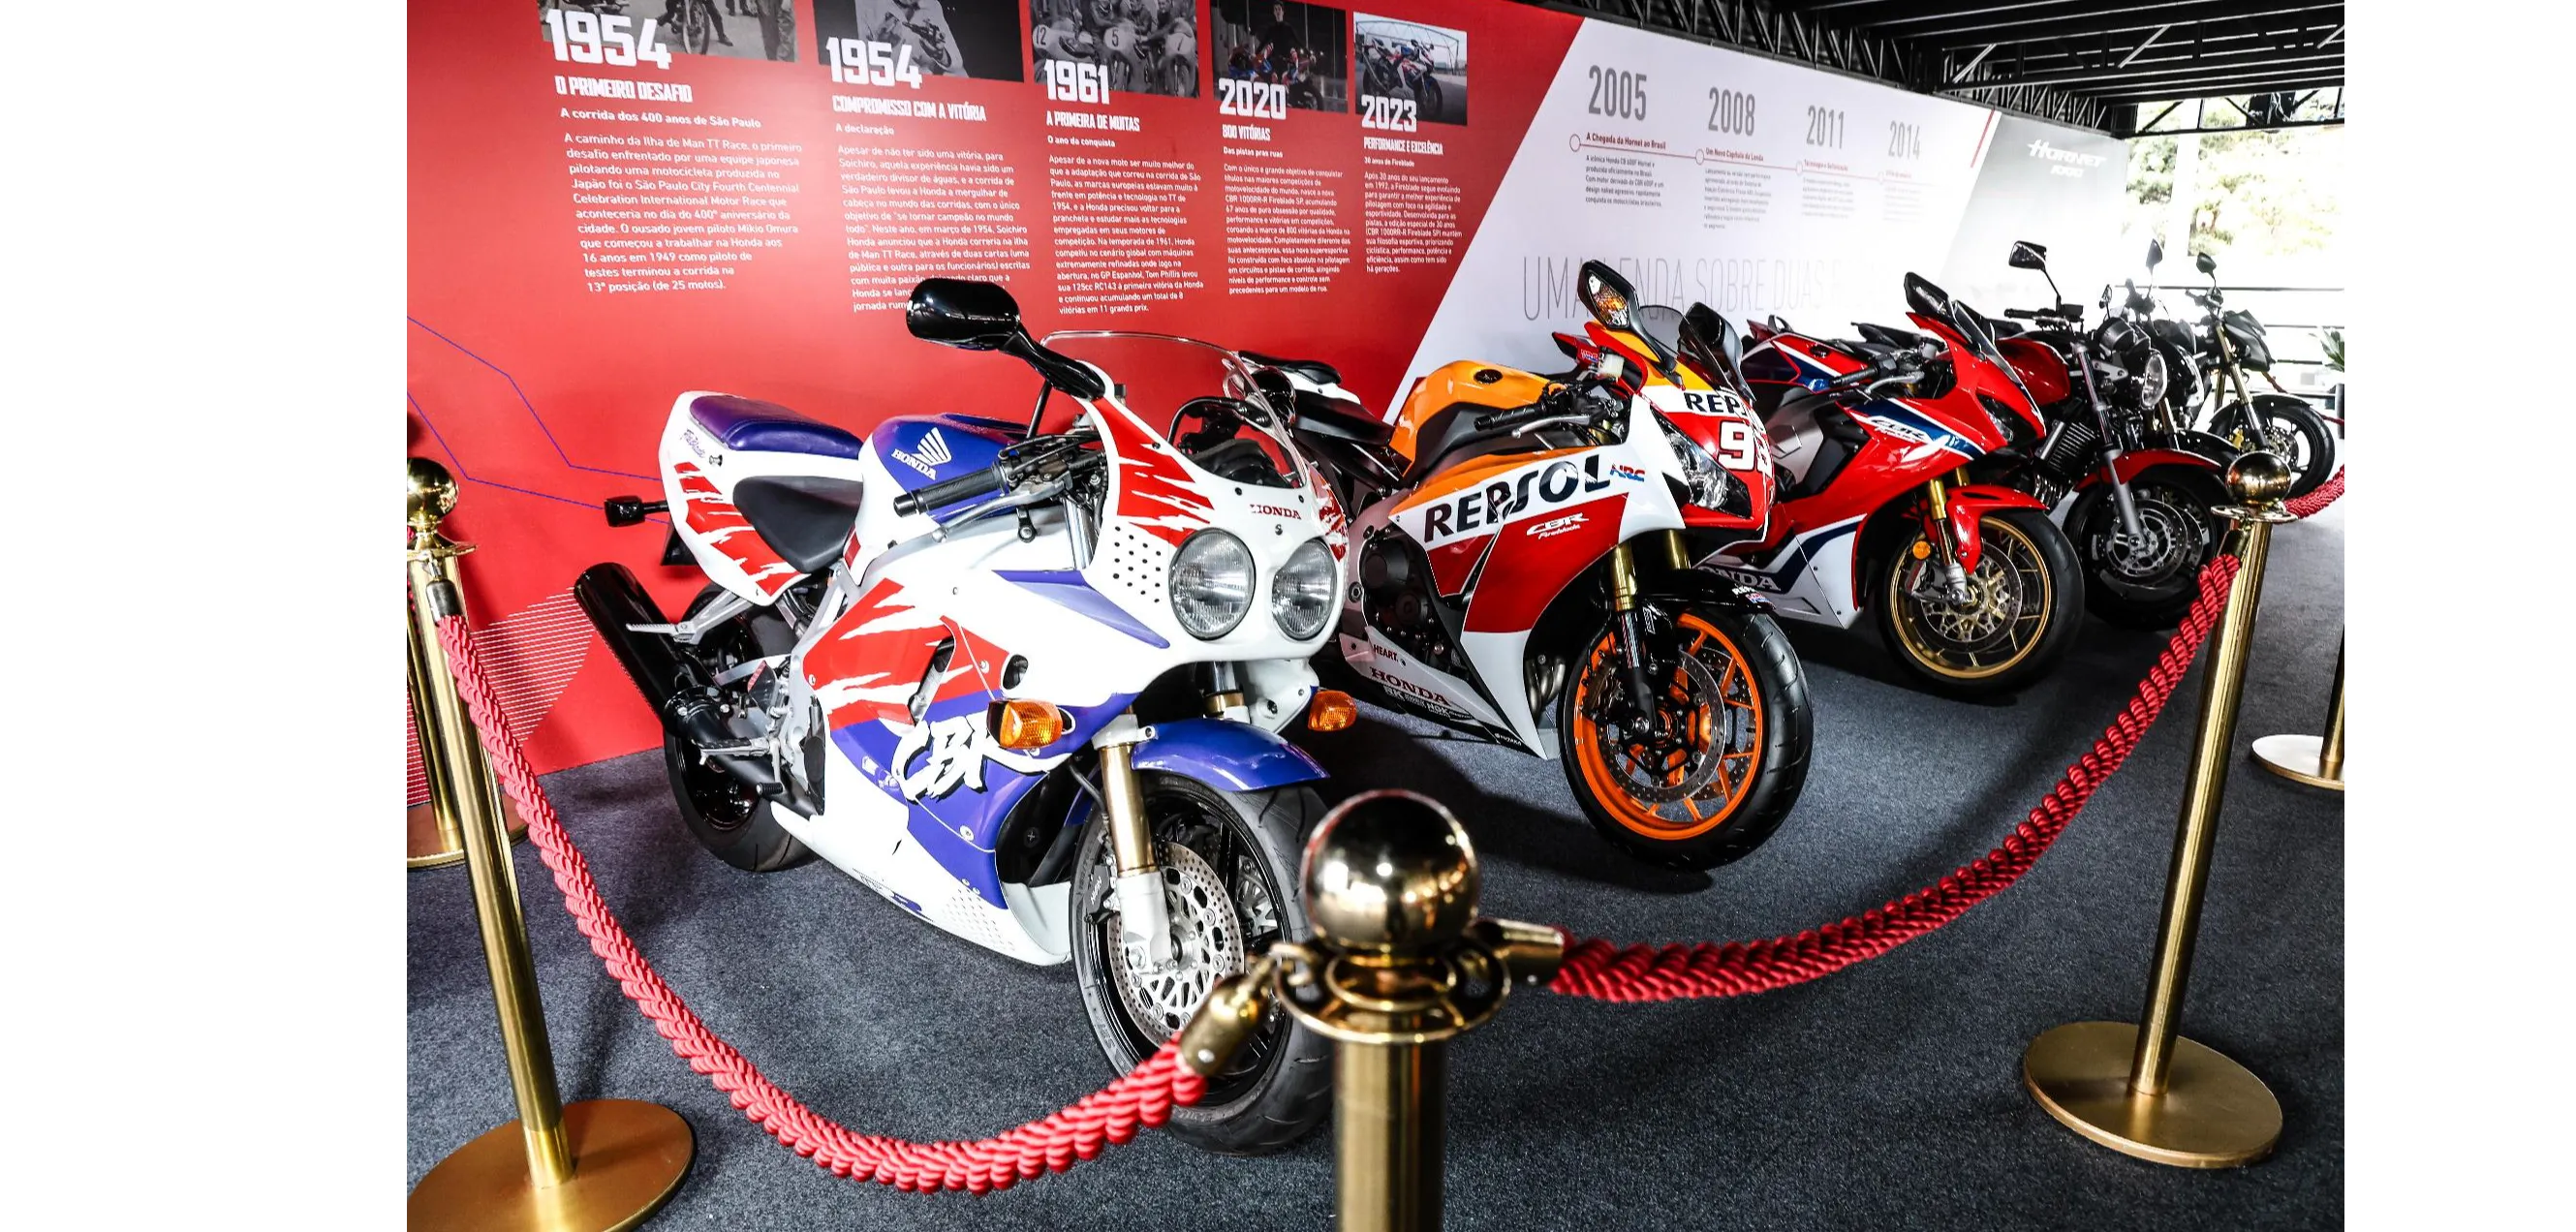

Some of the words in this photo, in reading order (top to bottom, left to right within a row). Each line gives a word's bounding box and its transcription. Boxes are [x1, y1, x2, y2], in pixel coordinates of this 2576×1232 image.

[546, 9, 672, 70] 1954
[825, 37, 922, 89] 1954
[554, 76, 568, 94] O
[568, 77, 636, 99] PRIMEIRO
[636, 81, 693, 102] DESAFIO
[1044, 58, 1109, 105] 1961
[1588, 65, 1647, 121] 2005
[831, 95, 912, 117] COMPROMISSO
[913, 101, 937, 119] COM
[938, 102, 947, 119] A
[947, 103, 986, 122] VITÓRIA
[1219, 77, 1287, 120] 2020
[560, 108, 570, 117] A
[572, 108, 615, 119] corrida
[617, 110, 639, 120] dos
[640, 111, 663, 122] 400
[693, 114, 707, 124] de
[709, 115, 729, 125] São
[730, 116, 761, 127] Paulo
[1045, 111, 1053, 126] A
[1053, 111, 1096, 129] PRIMEIRA
[1096, 114, 1108, 130] DE
[1108, 115, 1140, 132] MUITAS
[1361, 95, 1416, 133] 2023
[1708, 87, 1755, 137] 2008
[835, 123, 843, 133] A
[844, 124, 894, 136] declaração
[1222, 124, 1237, 140] 800
[1237, 125, 1270, 141] VITÓRIAS
[1807, 105, 1845, 149] 2011
[564, 134, 574, 142] A
[574, 134, 624, 144] caminho
[626, 136, 640, 145] da
[643, 137, 664, 146] Ilha
[666, 138, 680, 146] de
[682, 138, 704, 147] Man
[706, 139, 720, 148] TT
[1070, 137, 1079, 145] da
[1080, 138, 1115, 148] conquista
[1235, 147, 1255, 157] pistas
[1363, 137, 1406, 153] PERFORMANCE
[1406, 140, 1410, 153] E
[1411, 140, 1443, 156] EXCELÊNCIA
[1586, 132, 1591, 142] A
[1592, 133, 1616, 144] Chegada
[1616, 136, 1624, 145] da
[1624, 137, 1642, 147] Hornet
[1643, 139, 1650, 148] ao
[1651, 139, 1665, 150] Brasil
[1889, 120, 1920, 160] 2014
[566, 149, 608, 159] desafio
[610, 150, 671, 161] enfrentado
[673, 154, 691, 164] por
[719, 156, 754, 166] equipe
[572, 179, 605, 191] Japão
[607, 180, 623, 189] foi
[634, 180, 656, 190] São
[658, 181, 688, 190] Paulo
[690, 181, 710, 192] City
[712, 181, 746, 191] Fourth
[747, 182, 799, 192] Centennial
[573, 194, 637, 203] Celebration
[639, 195, 707, 204] International
[710, 196, 738, 204] Motor
[741, 196, 767, 205] Race
[767, 199, 787, 207] que
[620, 224, 629, 232] O
[631, 224, 670, 232] ousado
[672, 226, 704, 234] jovem
[706, 224, 735, 234] piloto
[737, 224, 763, 232] Mikio
[765, 224, 798, 232] Omura
[582, 253, 597, 262] 16
[649, 252, 676, 261] 1949
[708, 251, 737, 262] piloto
[738, 251, 752, 260] de
[1695, 258, 1766, 313] SOBRE
[891, 448, 937, 480] HONDA
[1424, 454, 1610, 543] REPSOL
[1527, 512, 1589, 536] CBR
[1370, 666, 1452, 707] HONDA
